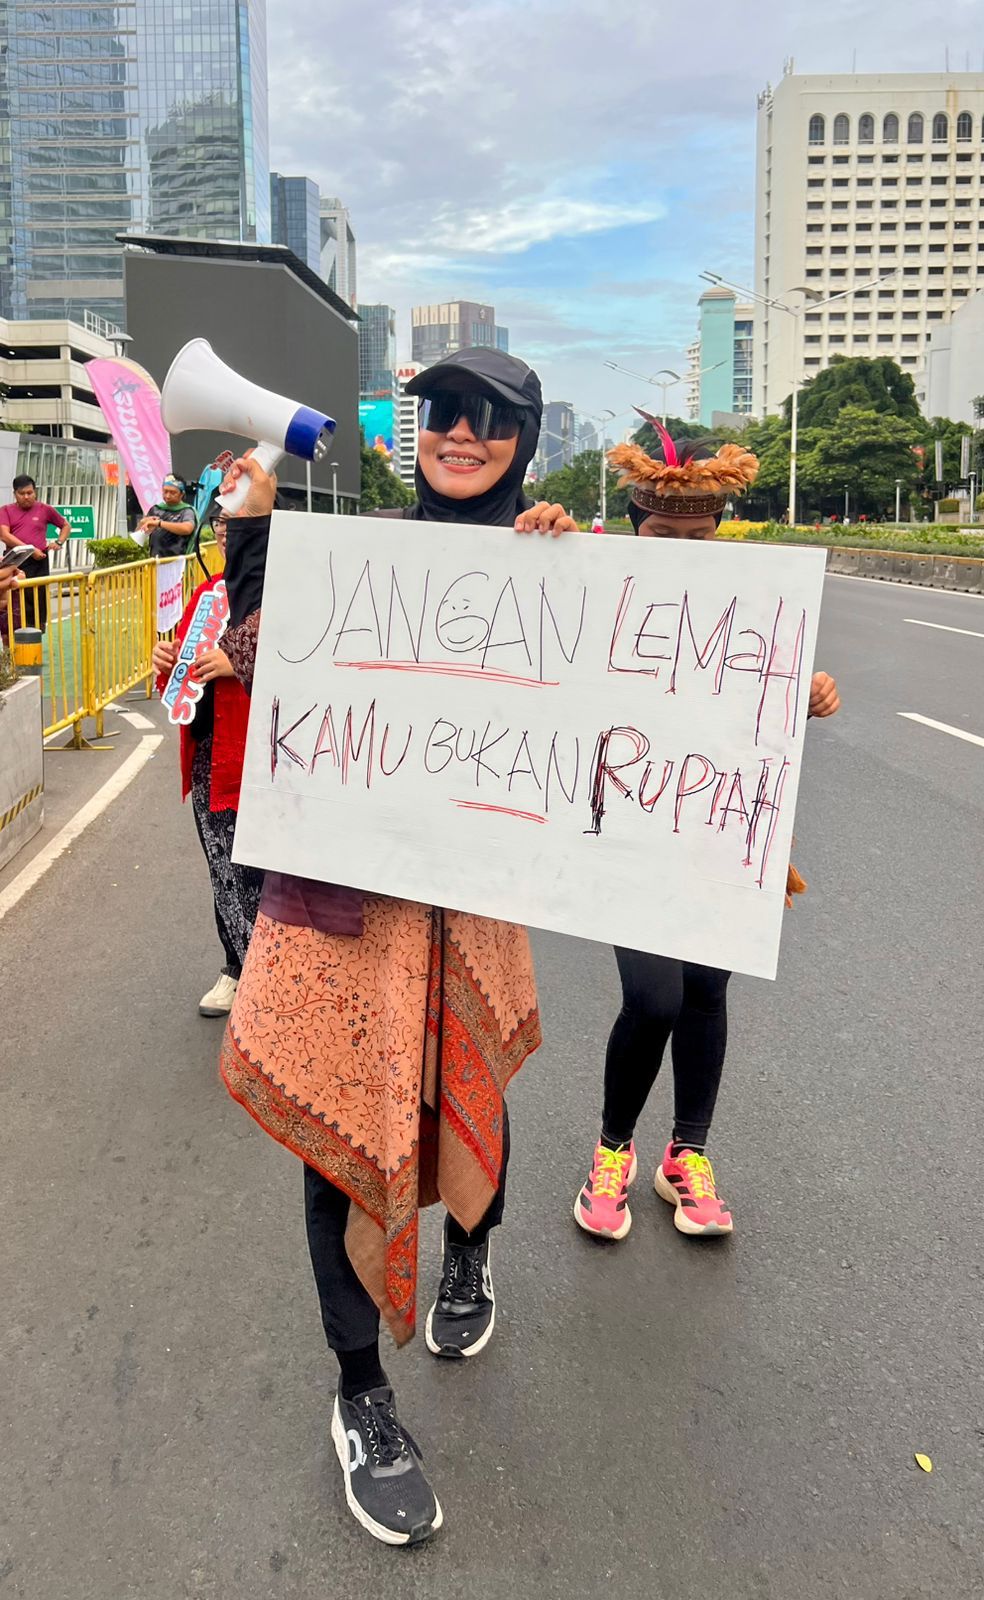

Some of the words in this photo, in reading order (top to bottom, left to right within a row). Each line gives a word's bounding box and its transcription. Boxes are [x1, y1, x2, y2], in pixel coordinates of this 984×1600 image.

[397, 368, 416, 378] ABB
[164, 662, 189, 707] AYO
[180, 594, 215, 661] FINISH
[277, 551, 586, 681] JANGAN
[271, 695, 412, 789] KAMU
[424, 718, 579, 812] BUKAN
[583, 725, 790, 889] RUPIAH
